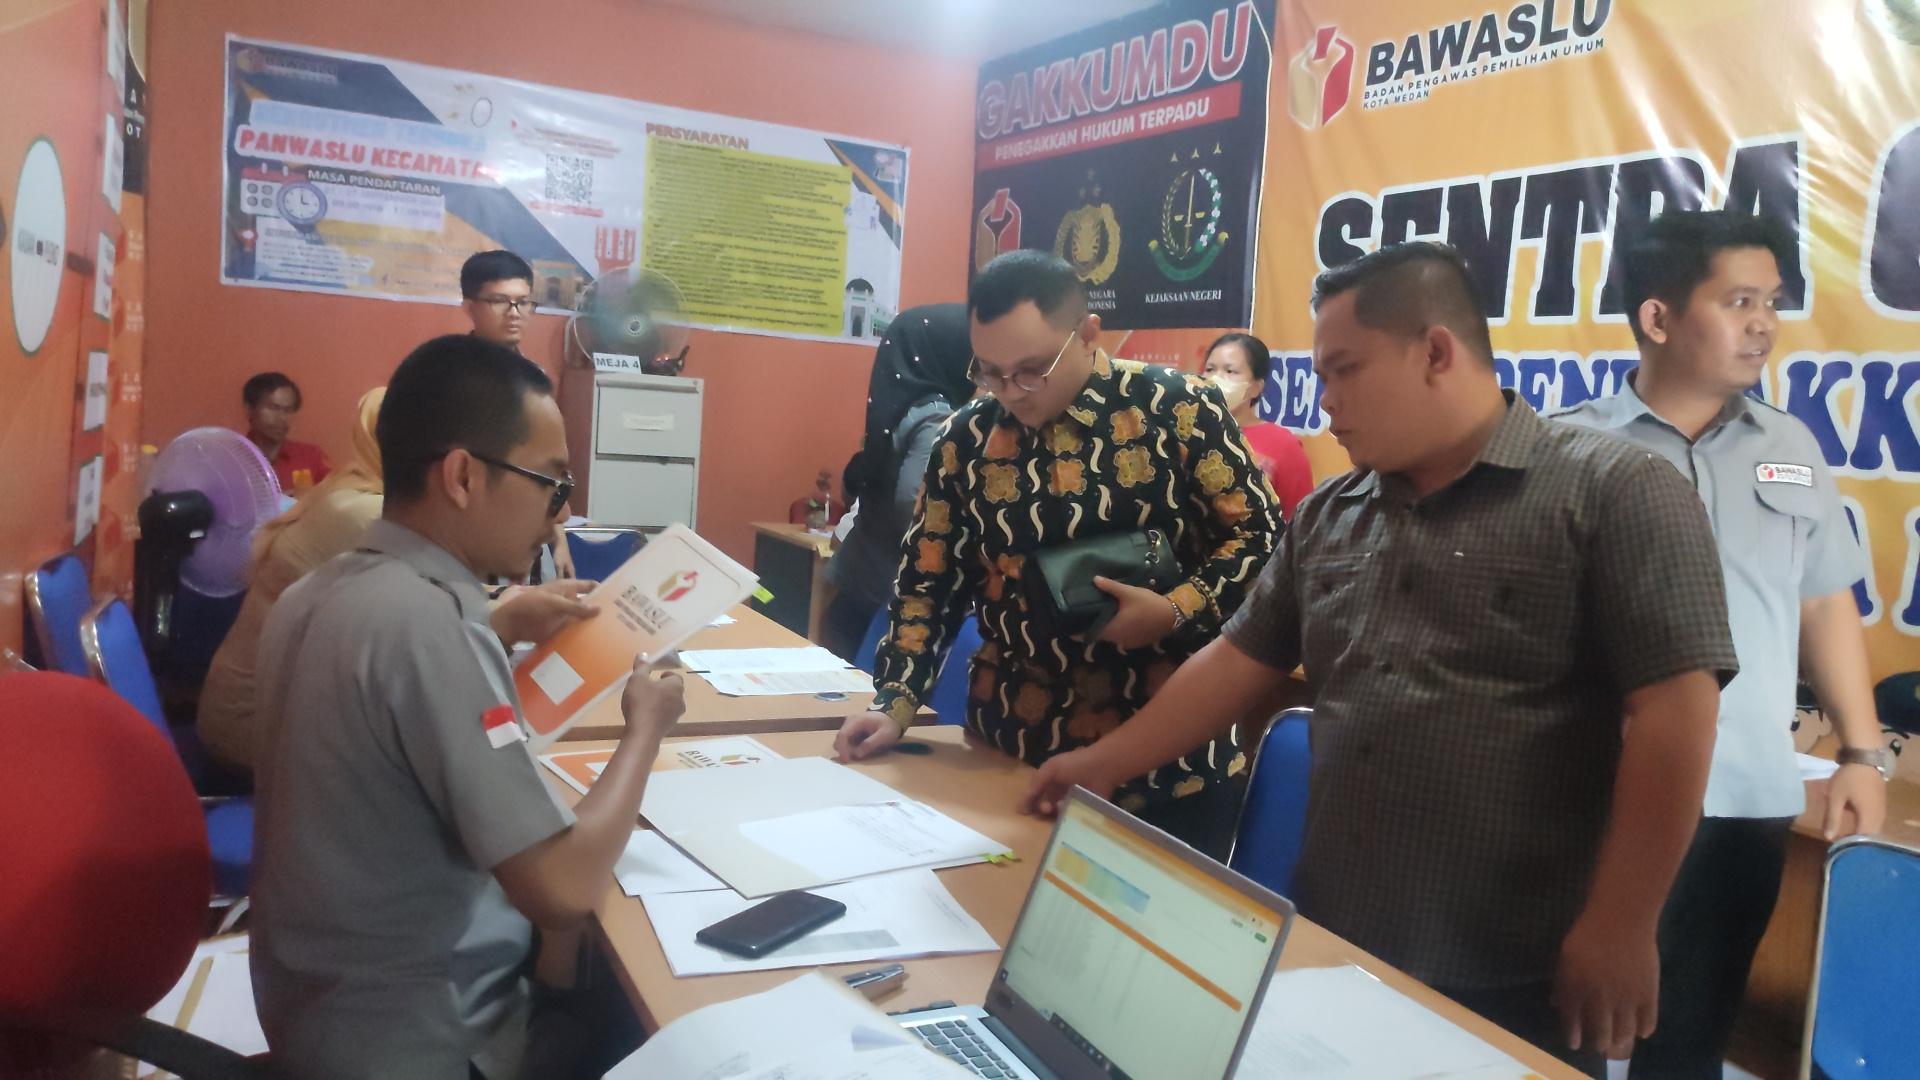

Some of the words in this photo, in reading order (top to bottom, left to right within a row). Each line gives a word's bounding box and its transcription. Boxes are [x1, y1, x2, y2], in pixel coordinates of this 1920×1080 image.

[1366, 0, 1610, 86] BAWASLU
[978, 1, 1252, 139] GAKKUMDU
[1364, 84, 1403, 99] BADAN
[1408, 68, 1477, 90] PENGAWAS
[1482, 49, 1558, 75] PEMILIHAN
[1563, 38, 1604, 56] UMUM
[1363, 98, 1390, 109] KOTA
[1394, 90, 1429, 103] MEDAN
[646, 122, 749, 149] PERSYARATAN
[995, 129, 1077, 161] PENEGAKKAN
[1081, 114, 1134, 141] HUKUM
[1139, 97, 1210, 128] TERPADU
[239, 129, 365, 164] PANWASLU
[371, 147, 499, 180] KECAMATA
[308, 170, 345, 183] MASA
[350, 175, 440, 195] PENDAFTARAN
[1145, 292, 1188, 303] KEJAKSAAN
[1190, 289, 1222, 301] NEGERI
[596, 358, 629, 368] MEJA
